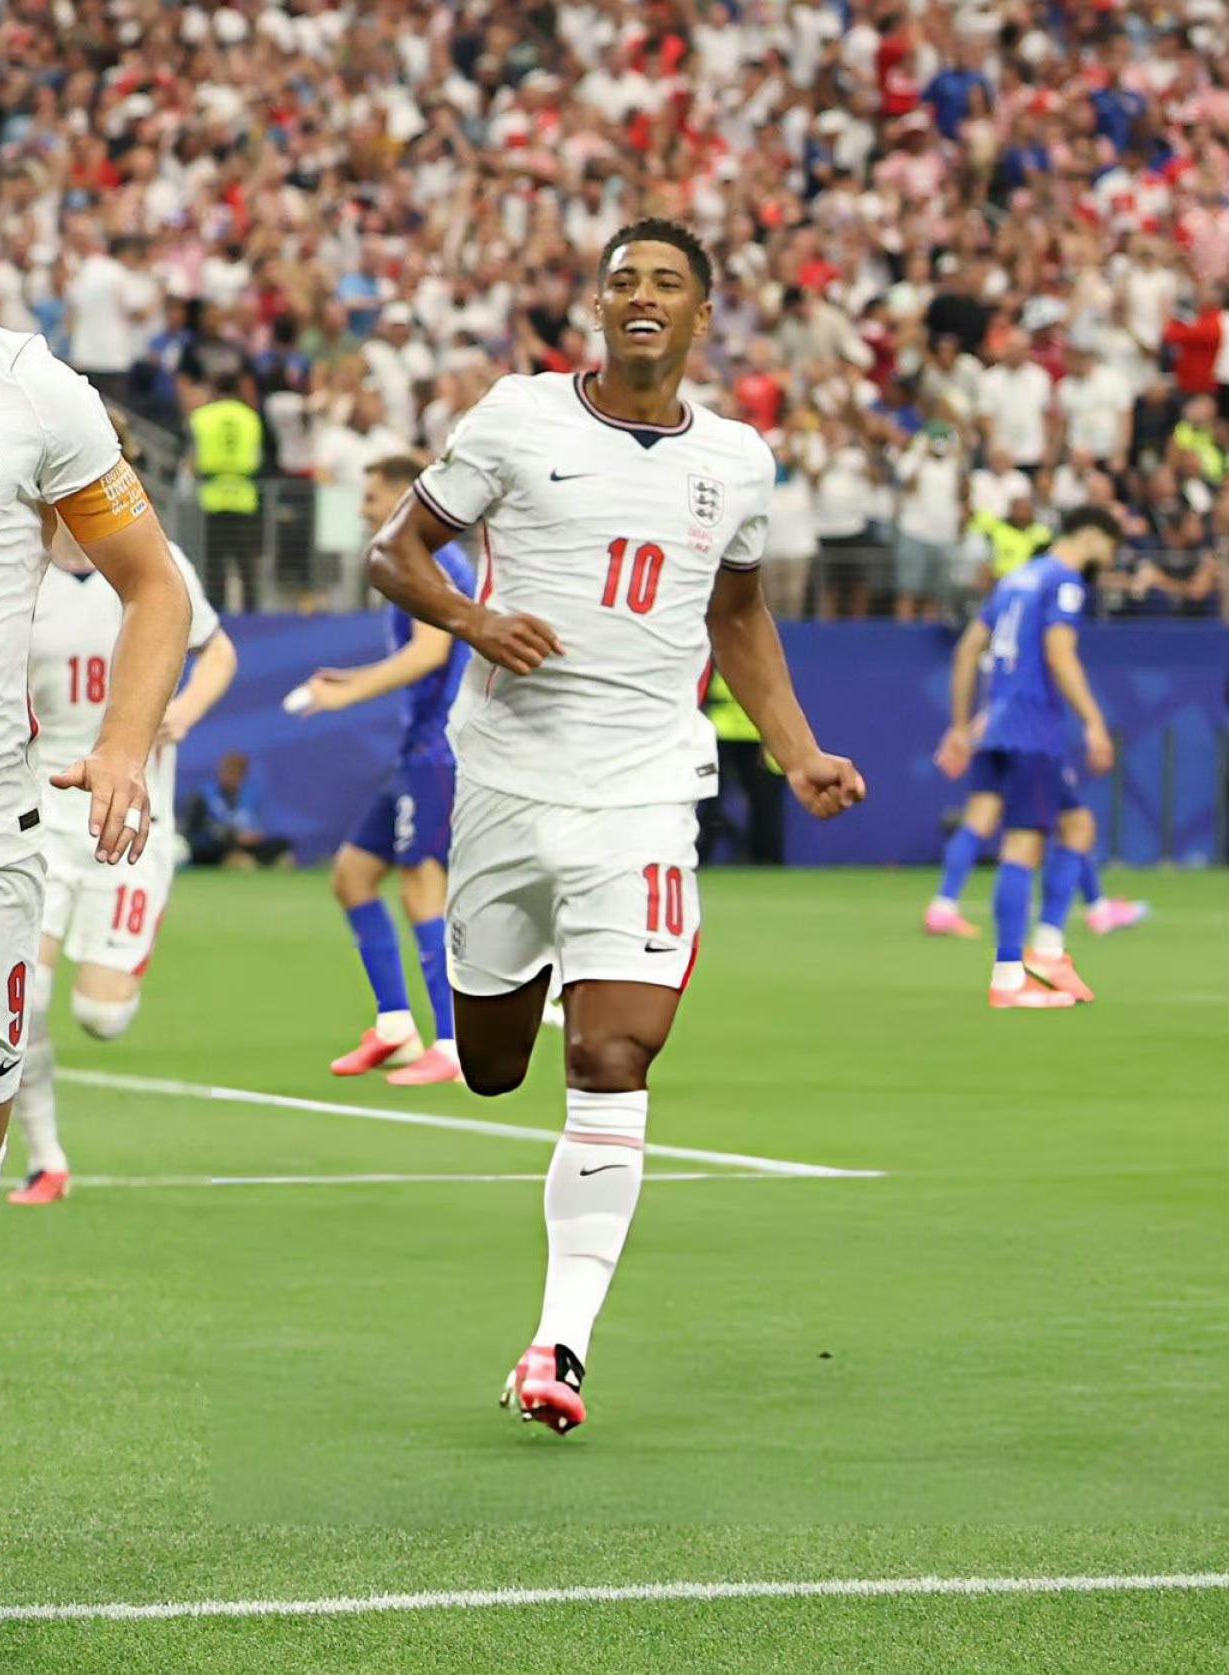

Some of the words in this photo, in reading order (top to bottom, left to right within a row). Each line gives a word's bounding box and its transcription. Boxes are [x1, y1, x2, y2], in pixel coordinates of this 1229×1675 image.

[601, 537, 665, 614] 10
[68, 656, 106, 703] 18
[111, 884, 146, 935] 18
[643, 863, 682, 935] 10
[7, 961, 26, 1047] 9
